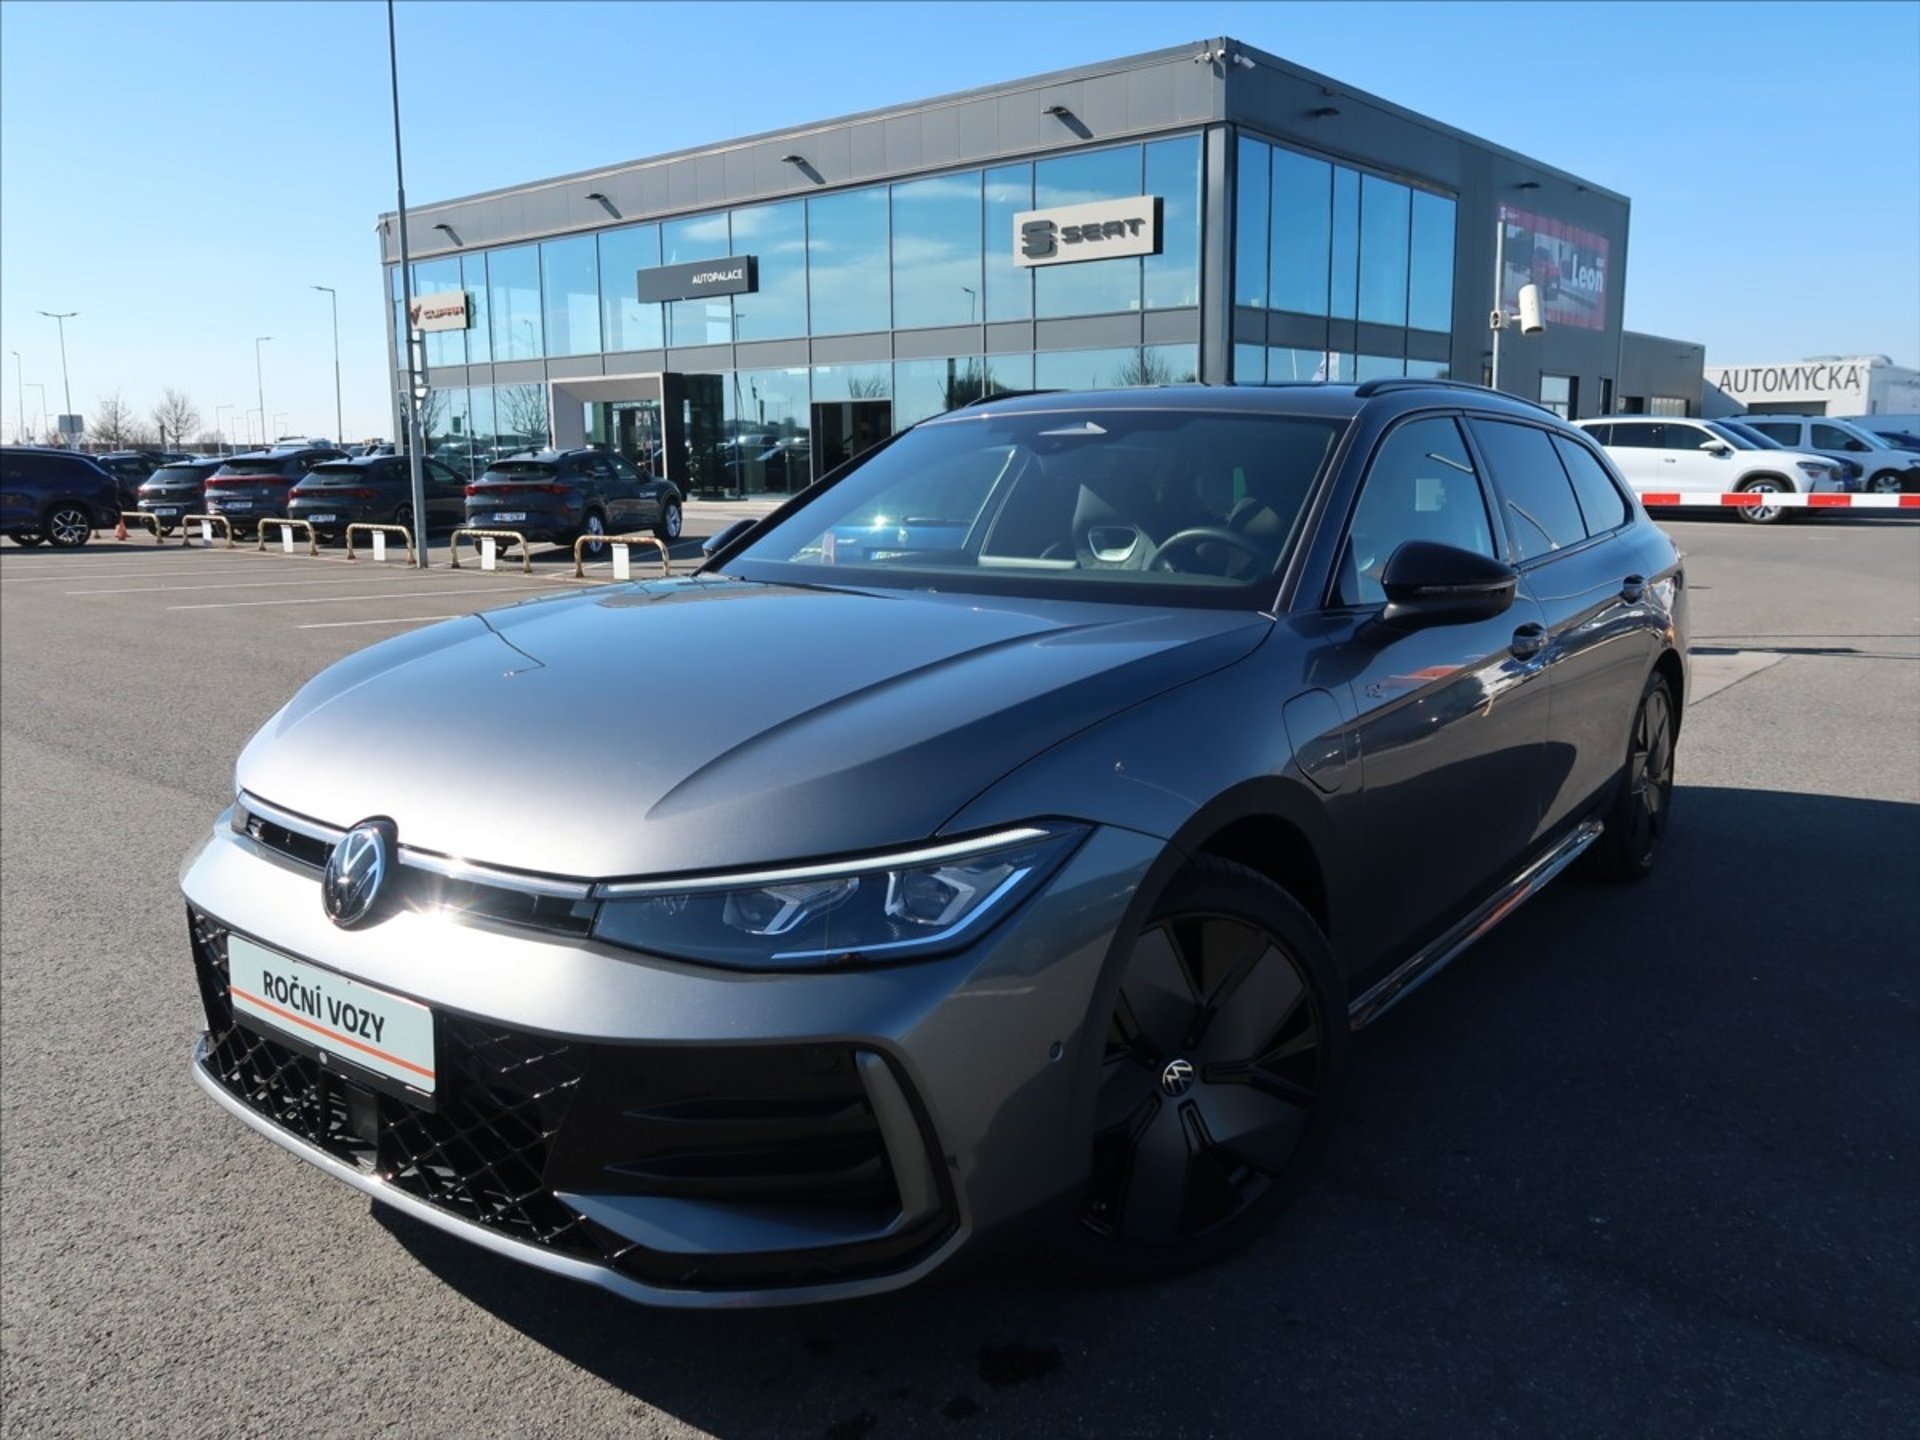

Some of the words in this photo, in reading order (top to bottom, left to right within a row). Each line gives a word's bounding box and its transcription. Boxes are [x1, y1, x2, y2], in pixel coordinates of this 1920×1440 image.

[1061, 217, 1146, 245] SEAT
[692, 268, 743, 285] AUTOPALACE
[1717, 362, 1861, 393] AUTOMYČKA
[263, 970, 322, 1019] ROČNÍ
[327, 996, 385, 1043] VOZY
